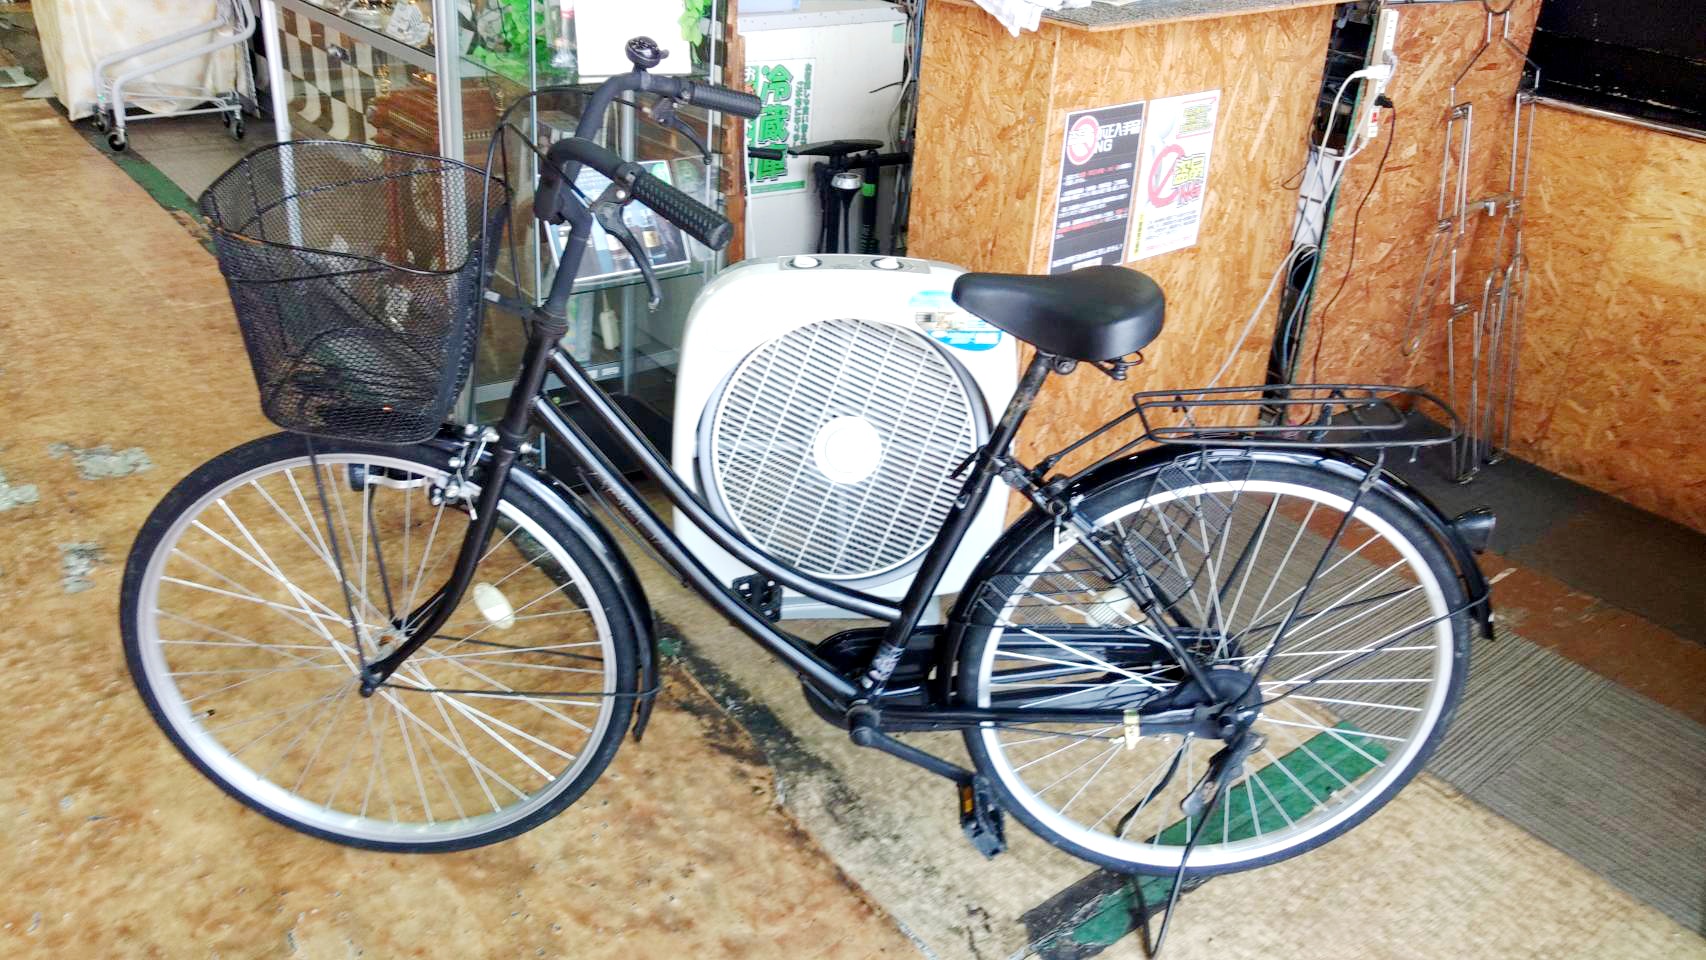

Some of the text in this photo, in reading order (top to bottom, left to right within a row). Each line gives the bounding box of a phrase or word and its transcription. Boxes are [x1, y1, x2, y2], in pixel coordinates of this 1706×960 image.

[756, 64, 792, 181] 冷蔵庫
[1095, 138, 1113, 153] NG
